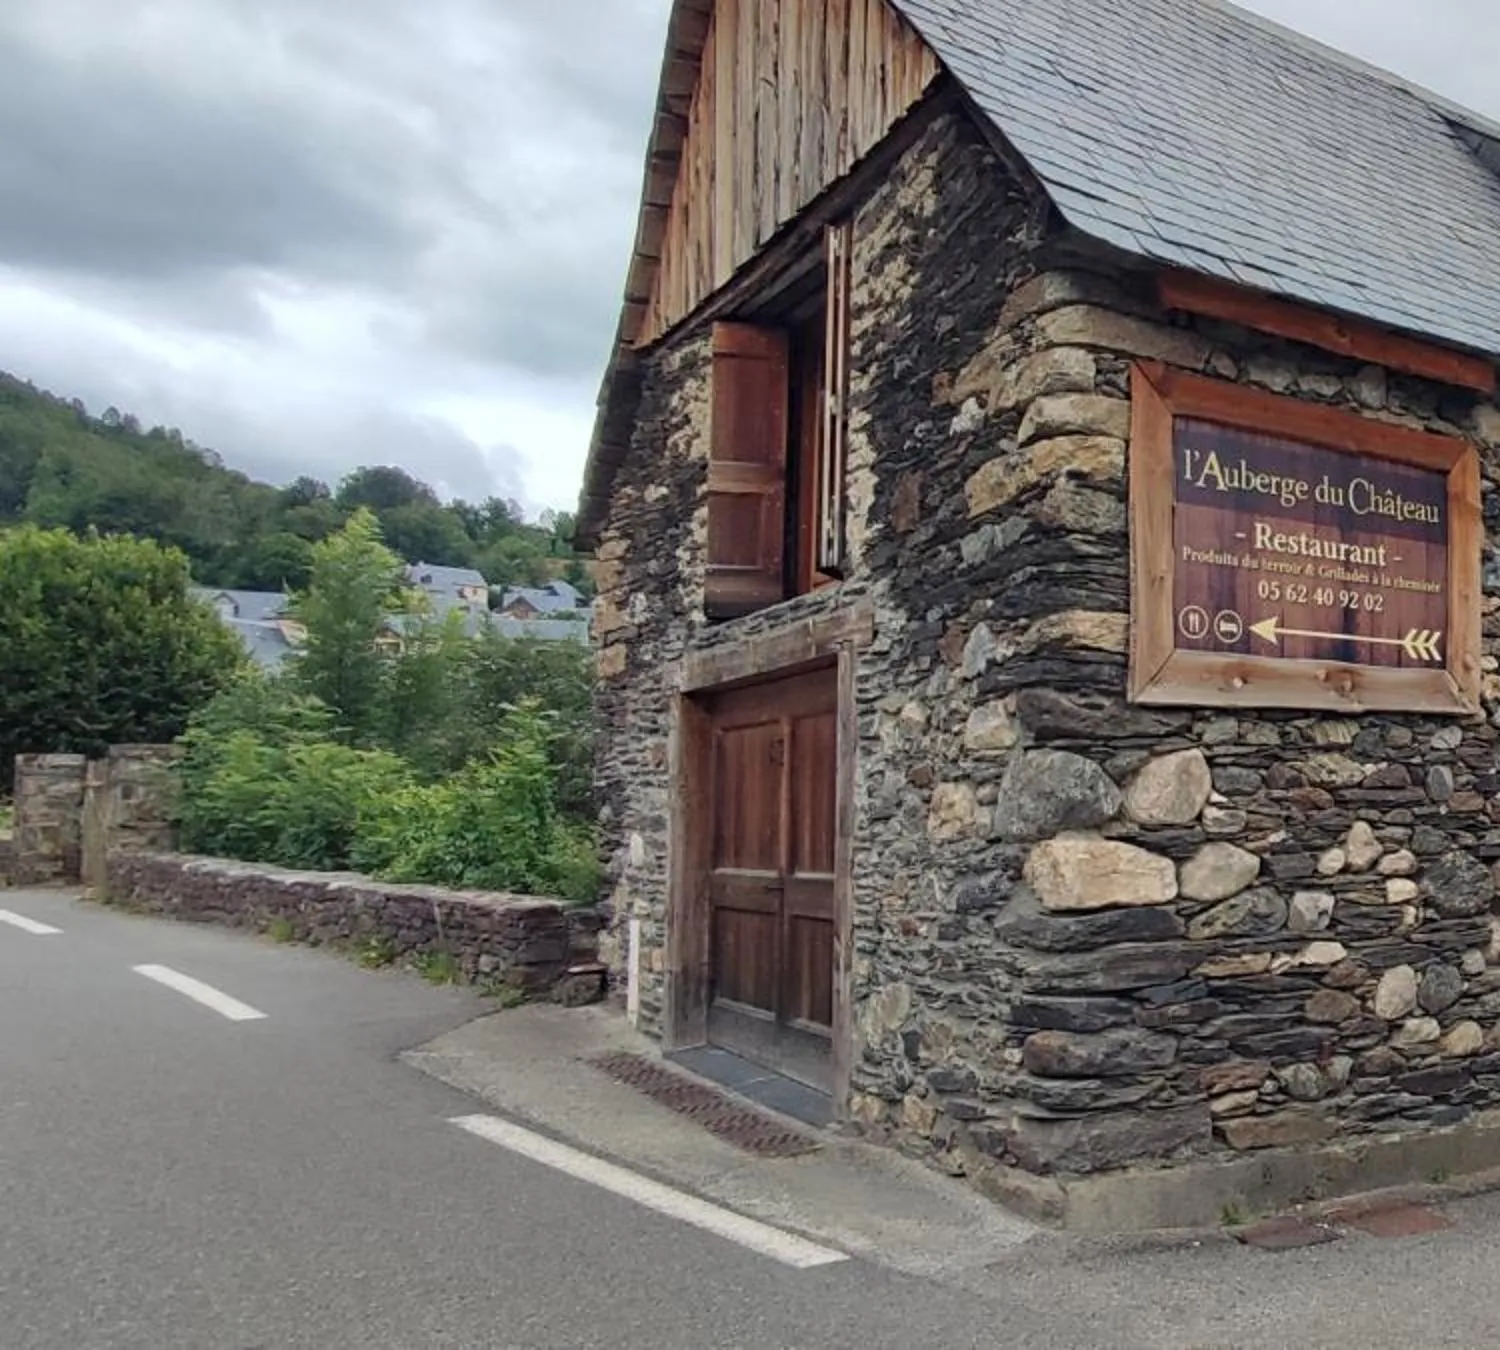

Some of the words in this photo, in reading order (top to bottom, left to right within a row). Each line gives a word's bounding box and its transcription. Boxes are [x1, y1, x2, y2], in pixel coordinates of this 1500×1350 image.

[1315, 475, 1345, 506] du
[1348, 477, 1440, 523] Château
[1254, 522, 1387, 567] Restaurant
[1183, 546, 1239, 567] Produits
[1241, 553, 1260, 569] du
[1261, 558, 1303, 575] terroir
[1304, 563, 1315, 577] &
[1318, 565, 1370, 583] Grillades
[1381, 573, 1391, 588] la
[1258, 580, 1280, 601] 05
[1286, 583, 1308, 603] 62
[1313, 587, 1334, 607] 40
[1340, 590, 1359, 609] 92
[1364, 593, 1384, 611] 02
